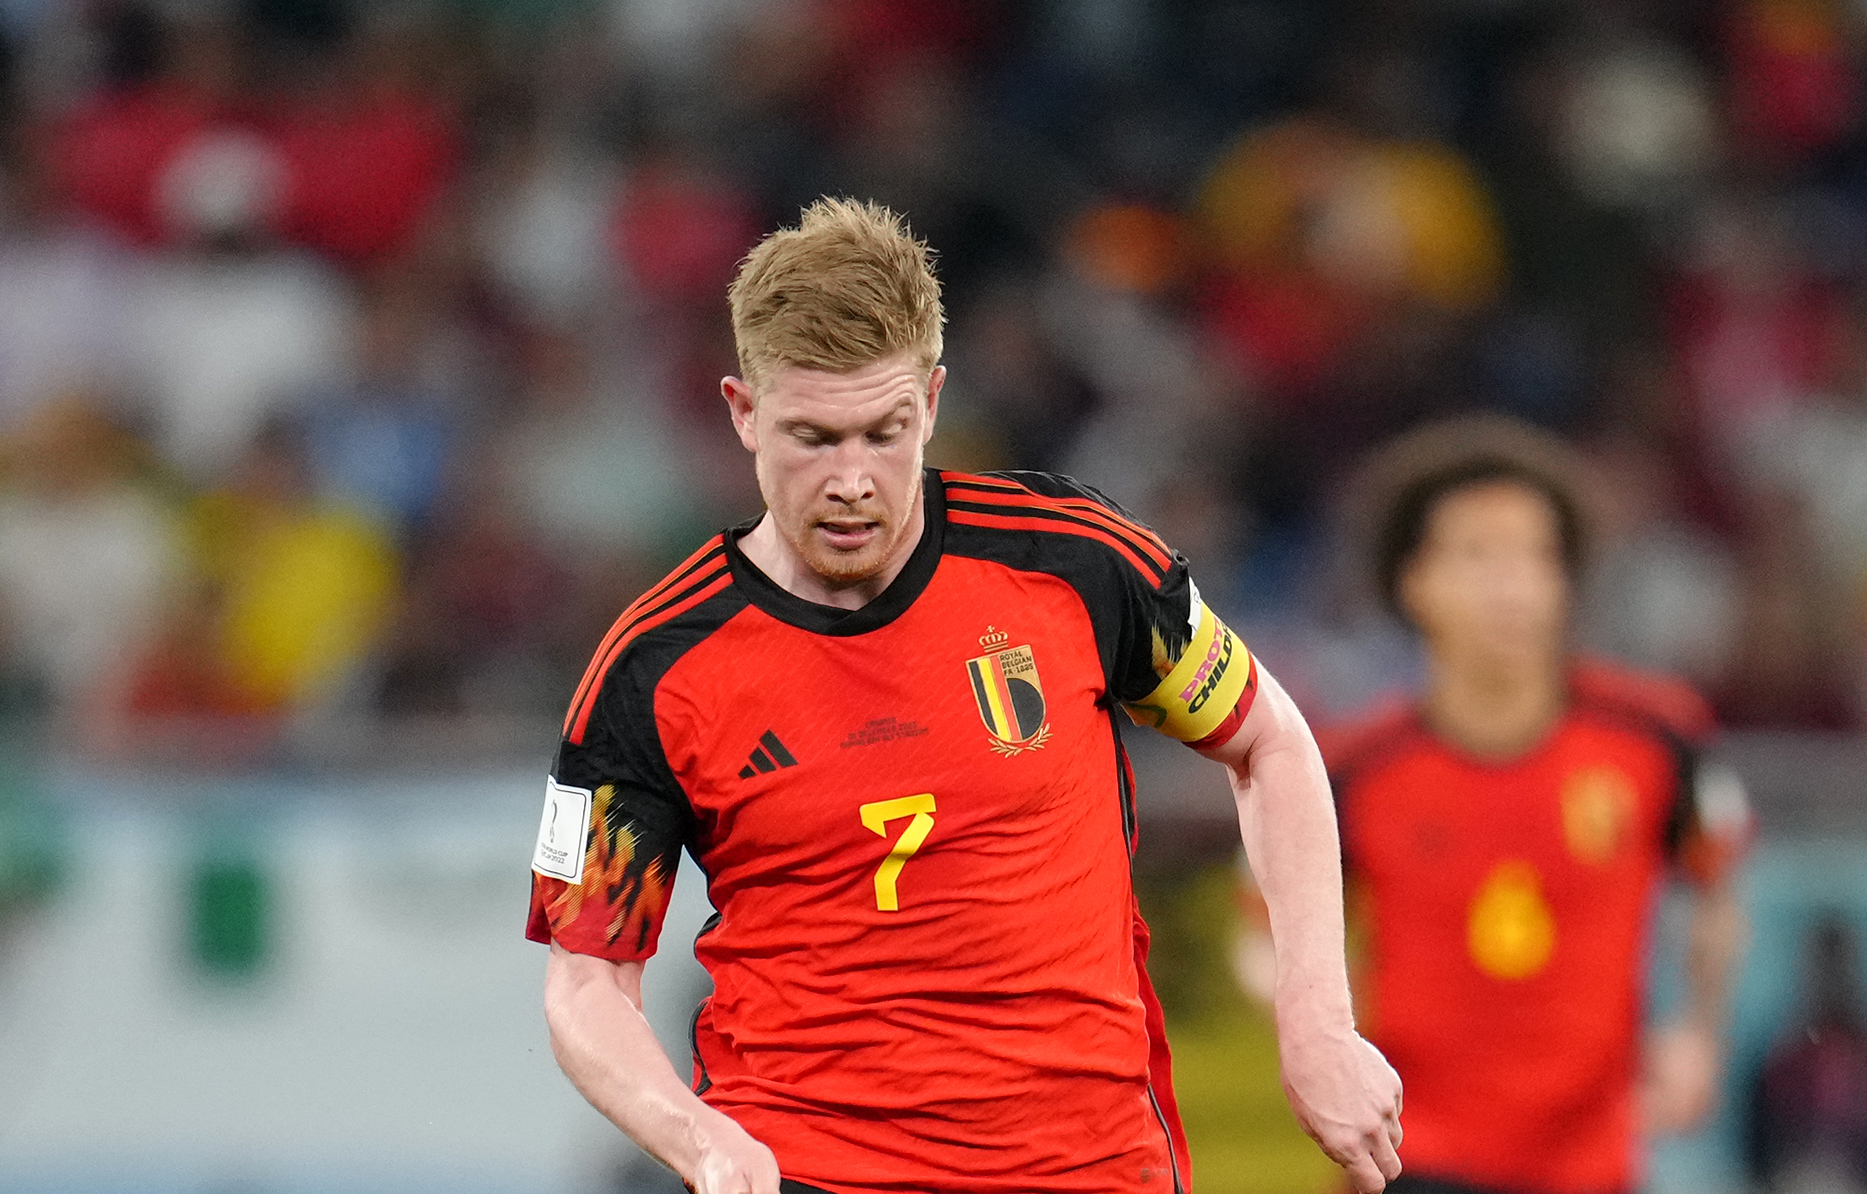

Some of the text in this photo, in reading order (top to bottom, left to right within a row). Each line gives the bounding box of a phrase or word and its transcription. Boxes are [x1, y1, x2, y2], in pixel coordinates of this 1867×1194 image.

[999, 650, 1023, 662] ROYAL
[1002, 655, 1032, 669] BELGIAN
[859, 792, 937, 911] 7
